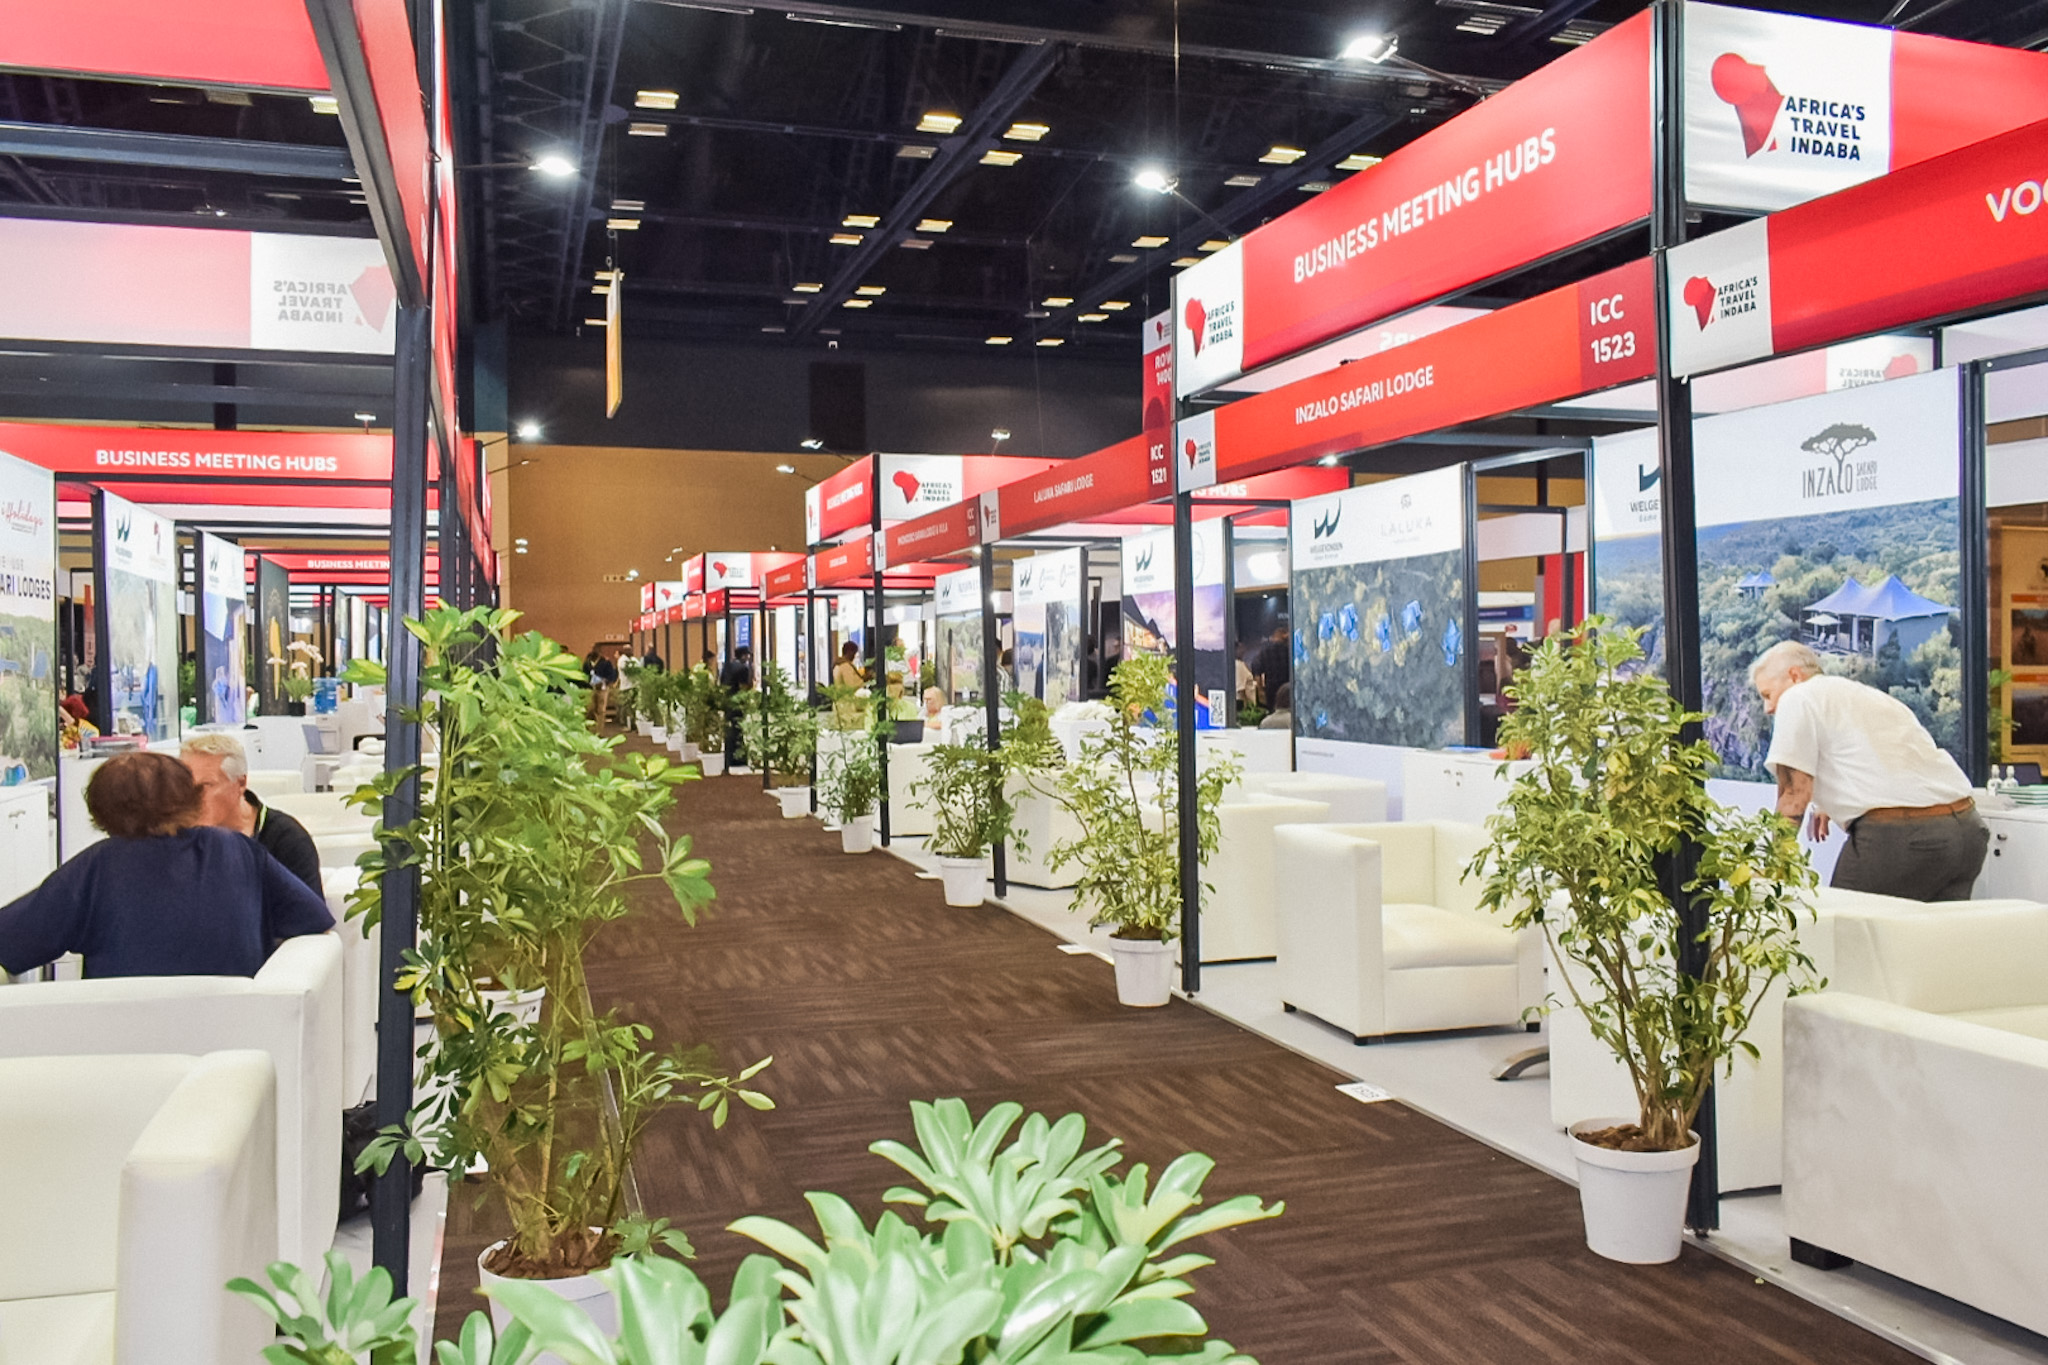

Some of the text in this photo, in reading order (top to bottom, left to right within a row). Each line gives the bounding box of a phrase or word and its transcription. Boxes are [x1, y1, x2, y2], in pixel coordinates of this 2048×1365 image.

[1785, 96, 1865, 121] AFRICA'S
[1790, 117, 1861, 140] TRAVEL
[1791, 136, 1860, 161] INDABA
[1294, 127, 1556, 284] BUSINESS MEETING HUBS
[1985, 179, 2048, 222] VO
[1718, 276, 1758, 296] AFRICA'S
[1720, 289, 1756, 307] TRAVEL
[1207, 300, 1235, 321] AFRICA'S
[1591, 293, 1625, 327] ICC
[1720, 301, 1757, 319] INDABA
[1208, 315, 1233, 333] TRAVEL
[1208, 328, 1233, 346] INDABA
[1591, 331, 1636, 364] 1523
[1295, 365, 1434, 425] INZALO SAFARI LODGE
[96, 449, 337, 472] BUSINESS MEETING HUBS
[1150, 444, 1164, 461] ICC
[1151, 467, 1167, 485] 1521
[1802, 463, 1853, 499] INZALO
[307, 559, 353, 569] BUSINESS
[18, 576, 51, 600] LODGES
